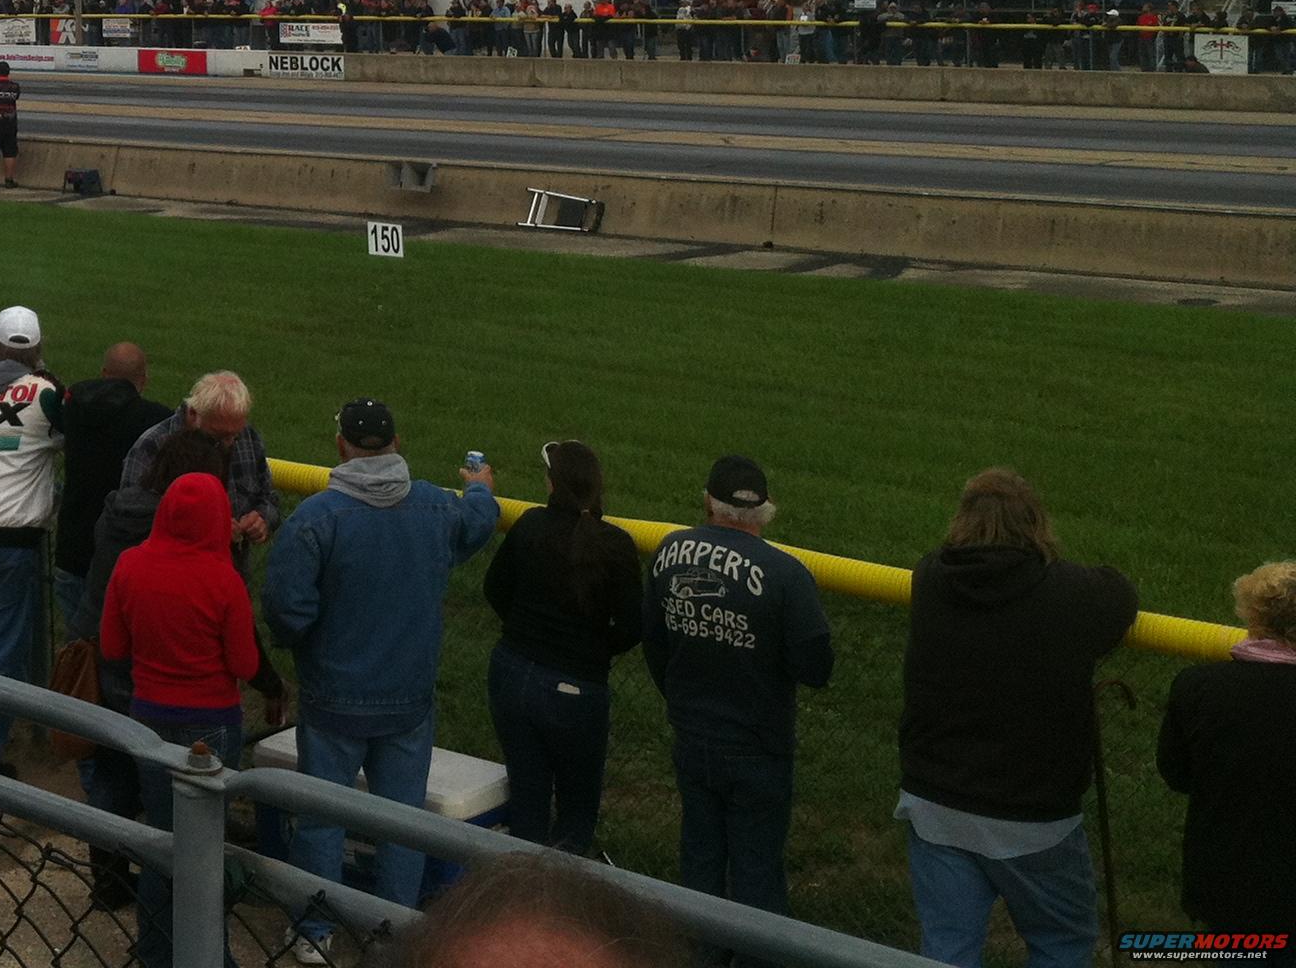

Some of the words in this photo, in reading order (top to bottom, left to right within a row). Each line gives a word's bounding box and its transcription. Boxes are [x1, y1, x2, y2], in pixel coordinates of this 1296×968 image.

[269, 55, 342, 72] NEBLOCK
[371, 224, 400, 254] 150
[653, 540, 765, 596] HARPER'S
[701, 604, 748, 631] CARS
